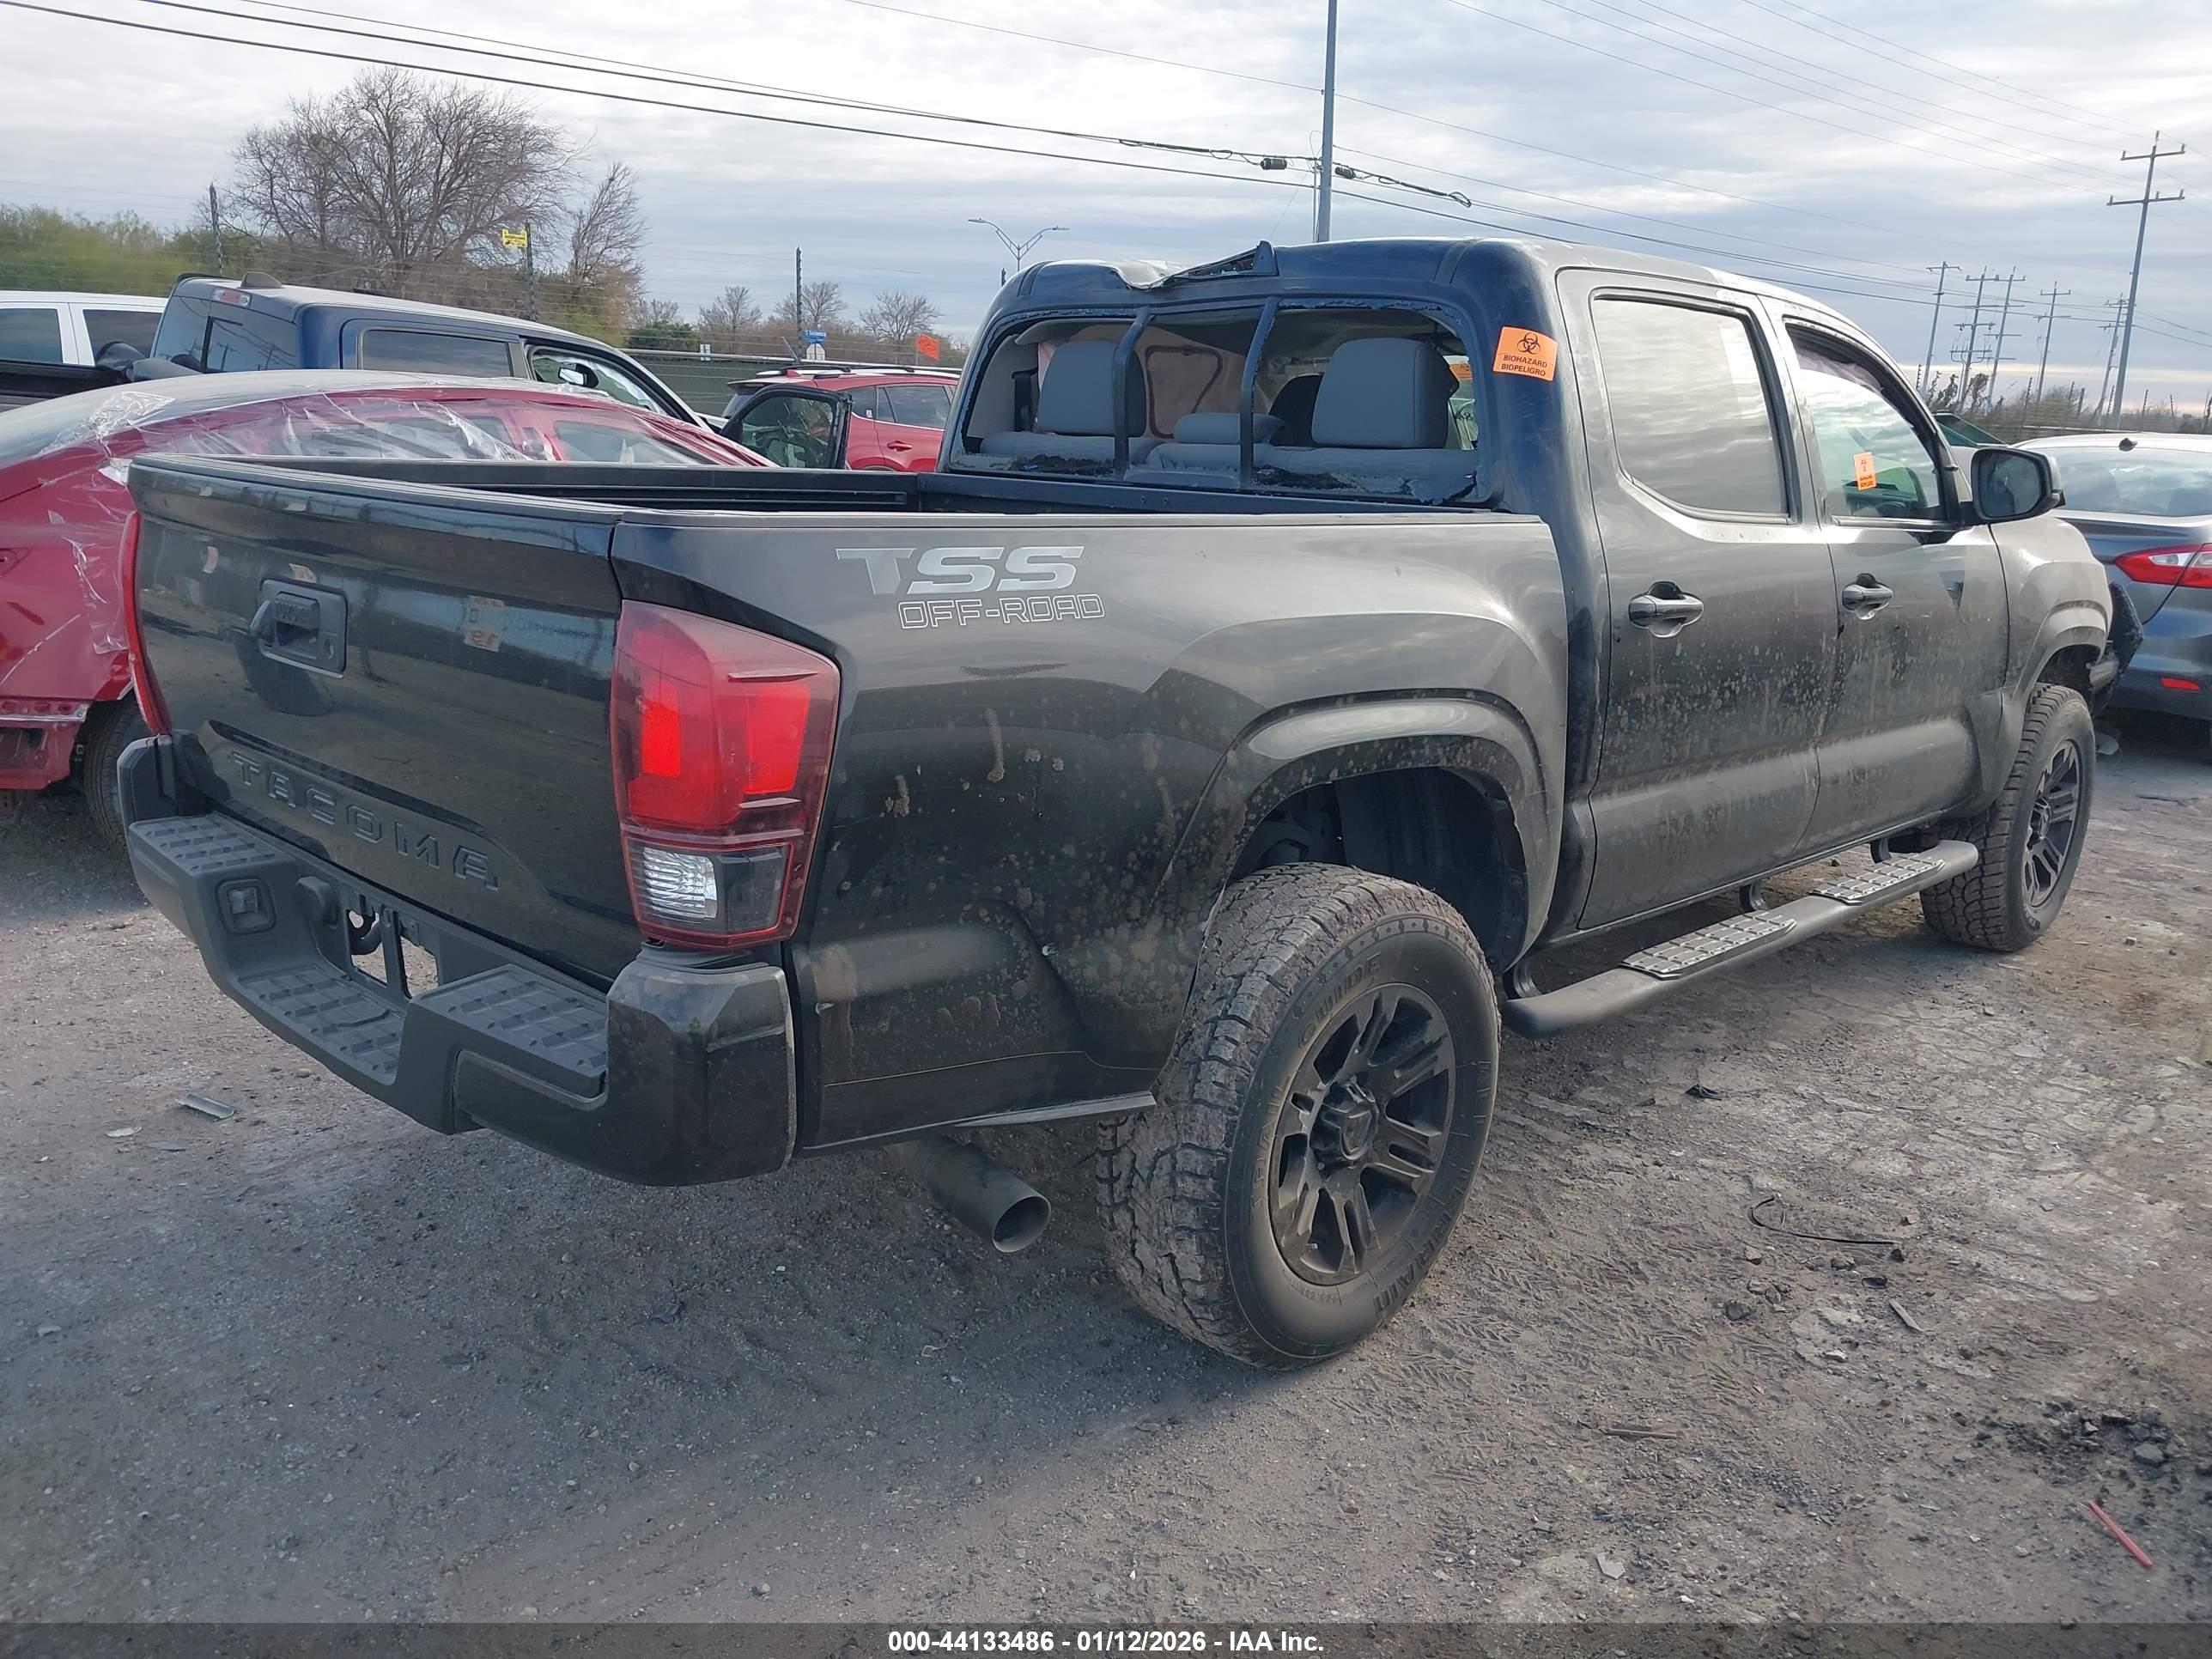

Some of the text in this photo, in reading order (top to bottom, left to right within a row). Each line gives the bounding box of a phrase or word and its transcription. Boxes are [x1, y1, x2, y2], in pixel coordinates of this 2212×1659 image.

[1500, 363, 1547, 377] BIOPELIGRO
[1503, 354, 1547, 368] BIOHAZARD
[835, 545, 1085, 596] TSS
[896, 593, 1106, 629] OFF-ROAD
[233, 750, 500, 893] TACOMA
